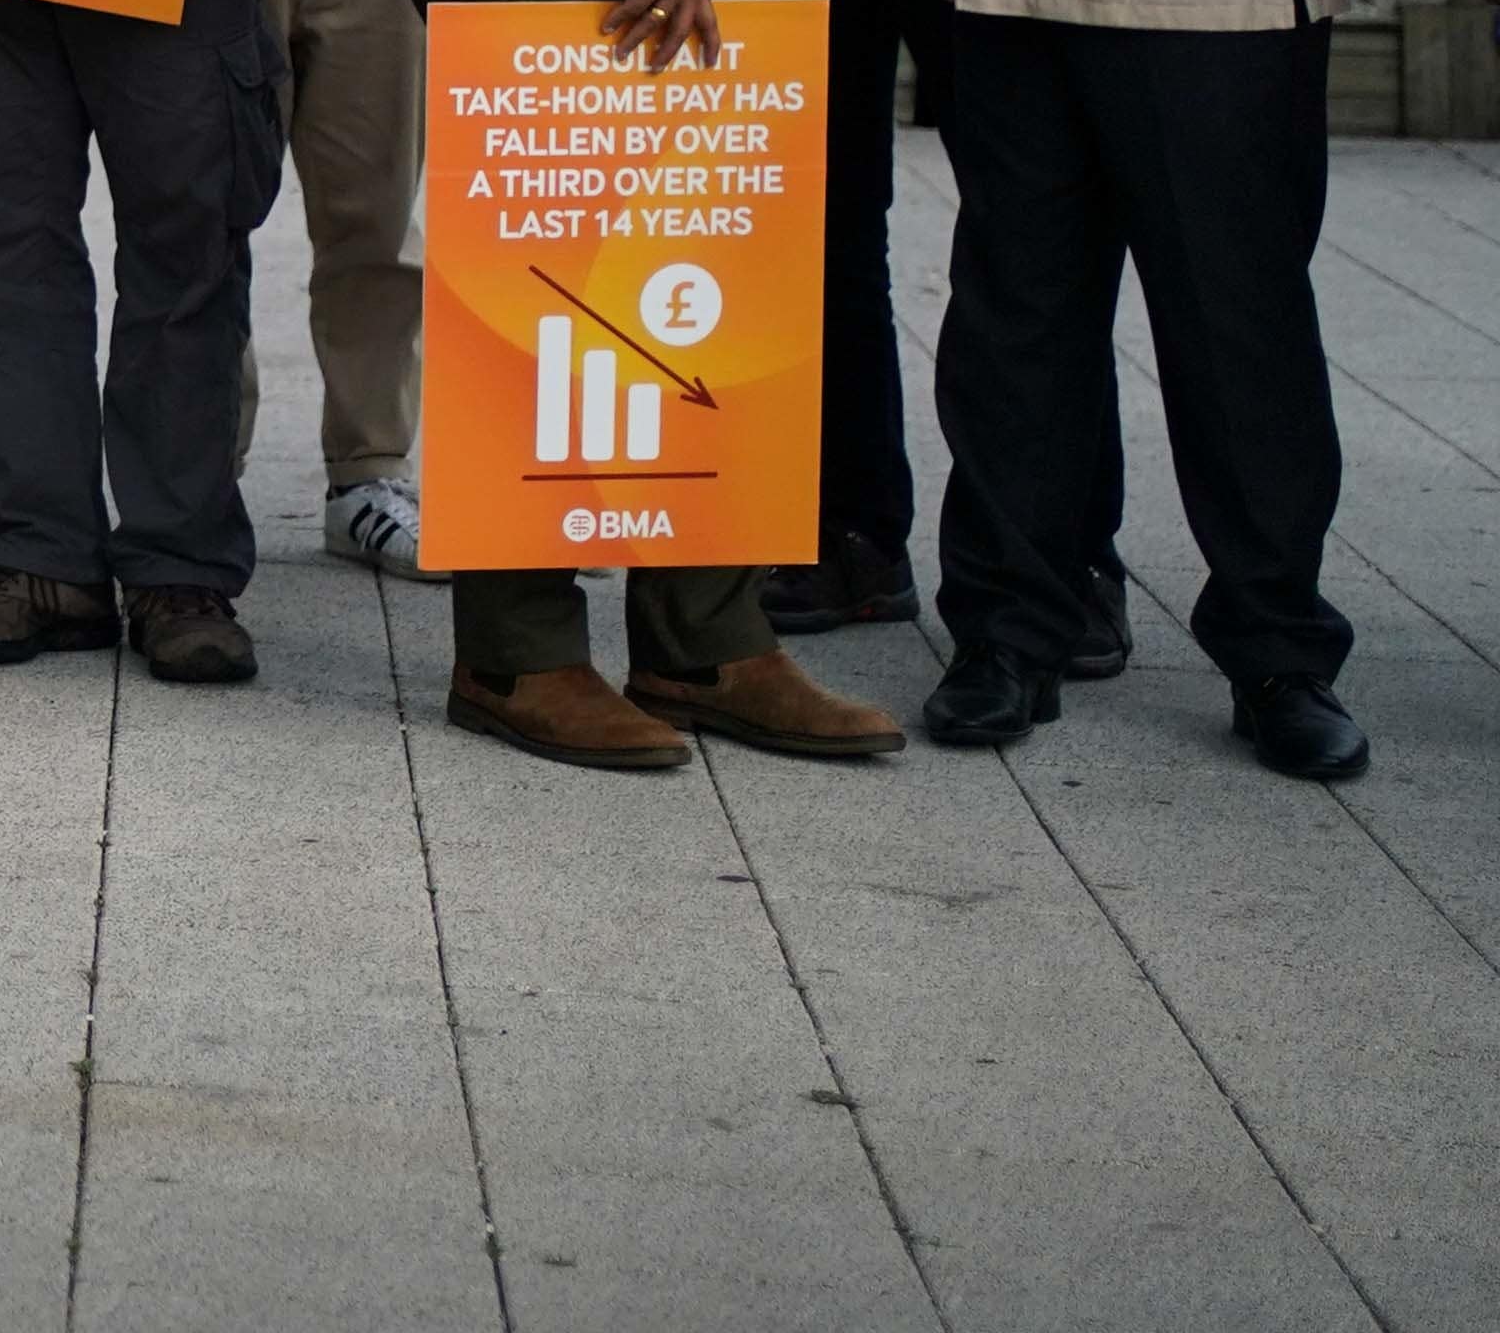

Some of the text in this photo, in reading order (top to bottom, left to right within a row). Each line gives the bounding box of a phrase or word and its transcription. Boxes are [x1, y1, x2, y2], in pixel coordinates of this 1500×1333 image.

[448, 81, 804, 116] TAKE-HOME PAY HAS
[485, 124, 769, 157] FALLEN BY OVER
[467, 165, 784, 198] A THIRD OVER THE
[499, 206, 753, 239] LAST 14 YEARS
[599, 510, 674, 539] BMA
